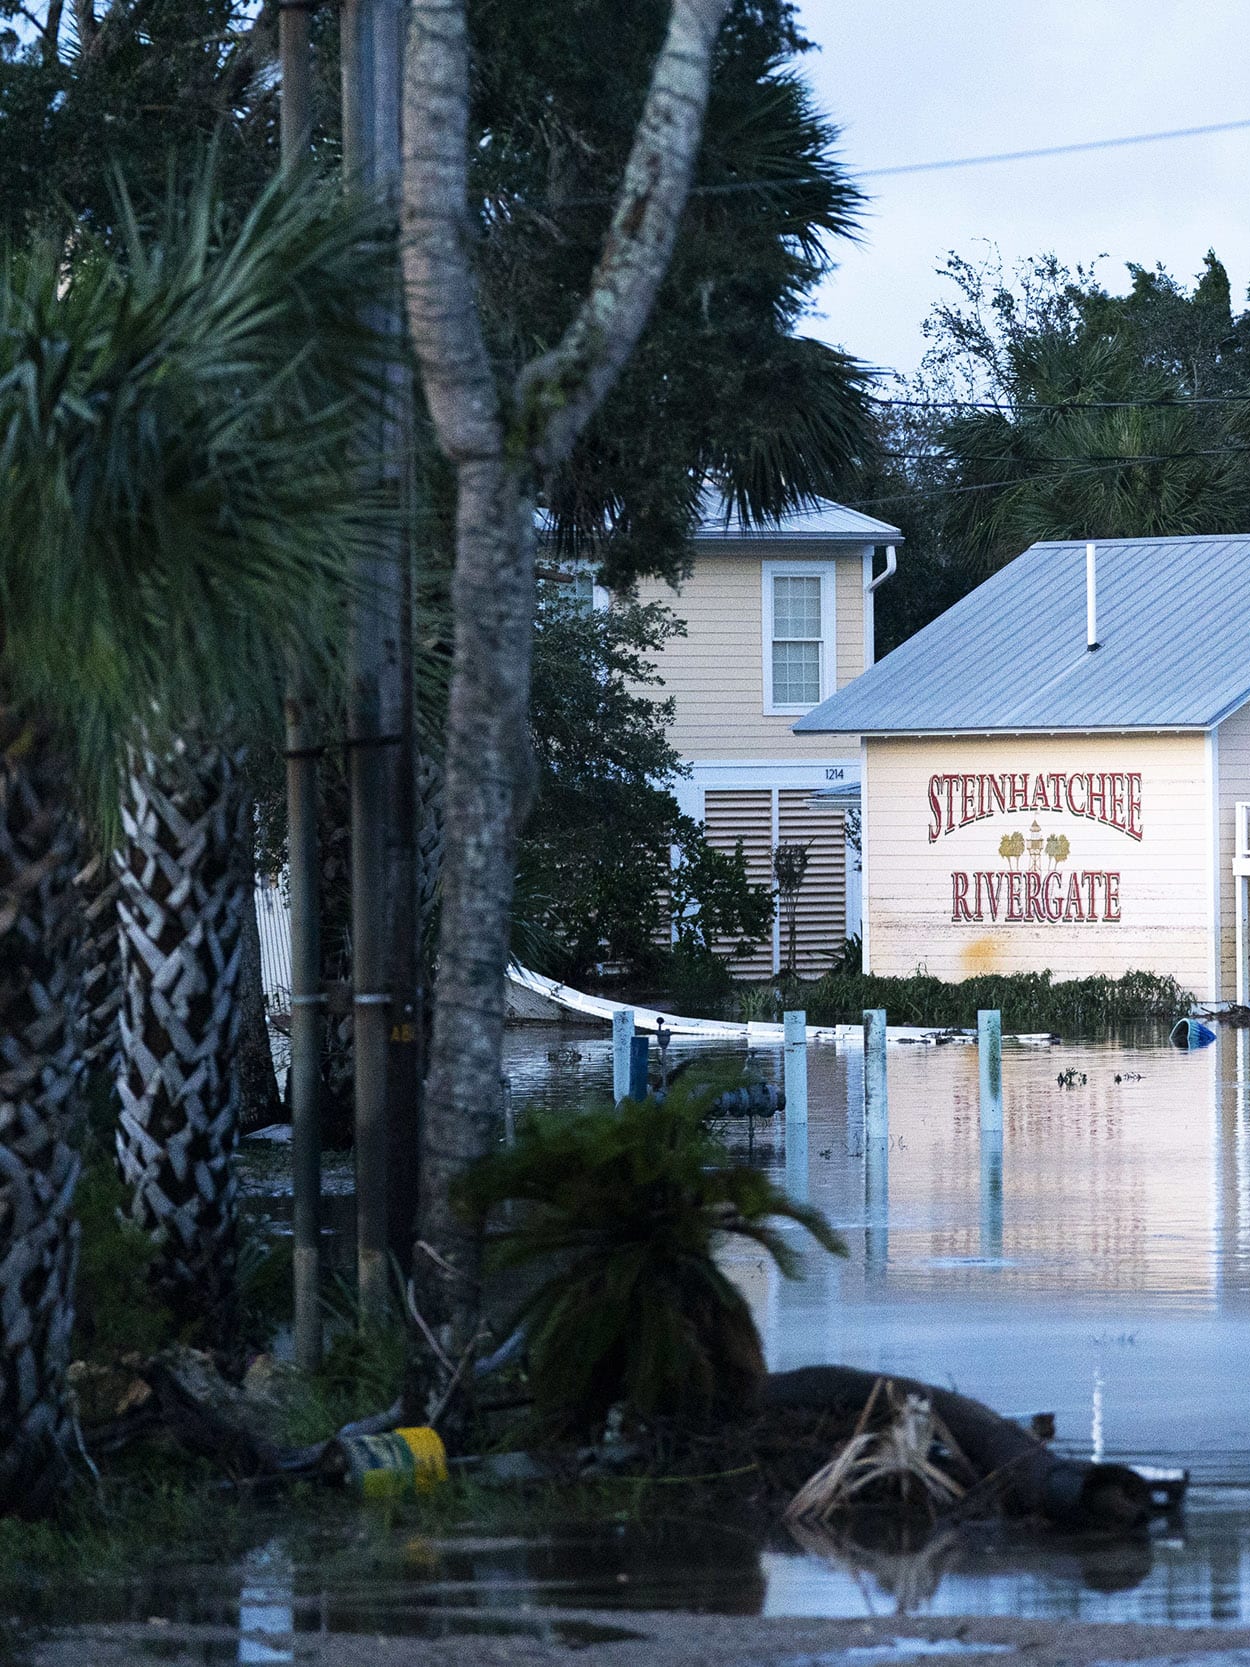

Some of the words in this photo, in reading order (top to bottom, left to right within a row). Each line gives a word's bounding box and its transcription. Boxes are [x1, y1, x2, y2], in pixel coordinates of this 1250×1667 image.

[825, 768, 844, 780] 1214
[928, 771, 1144, 844] STEINHATCHEE
[951, 870, 1122, 923] RIVERGATE
